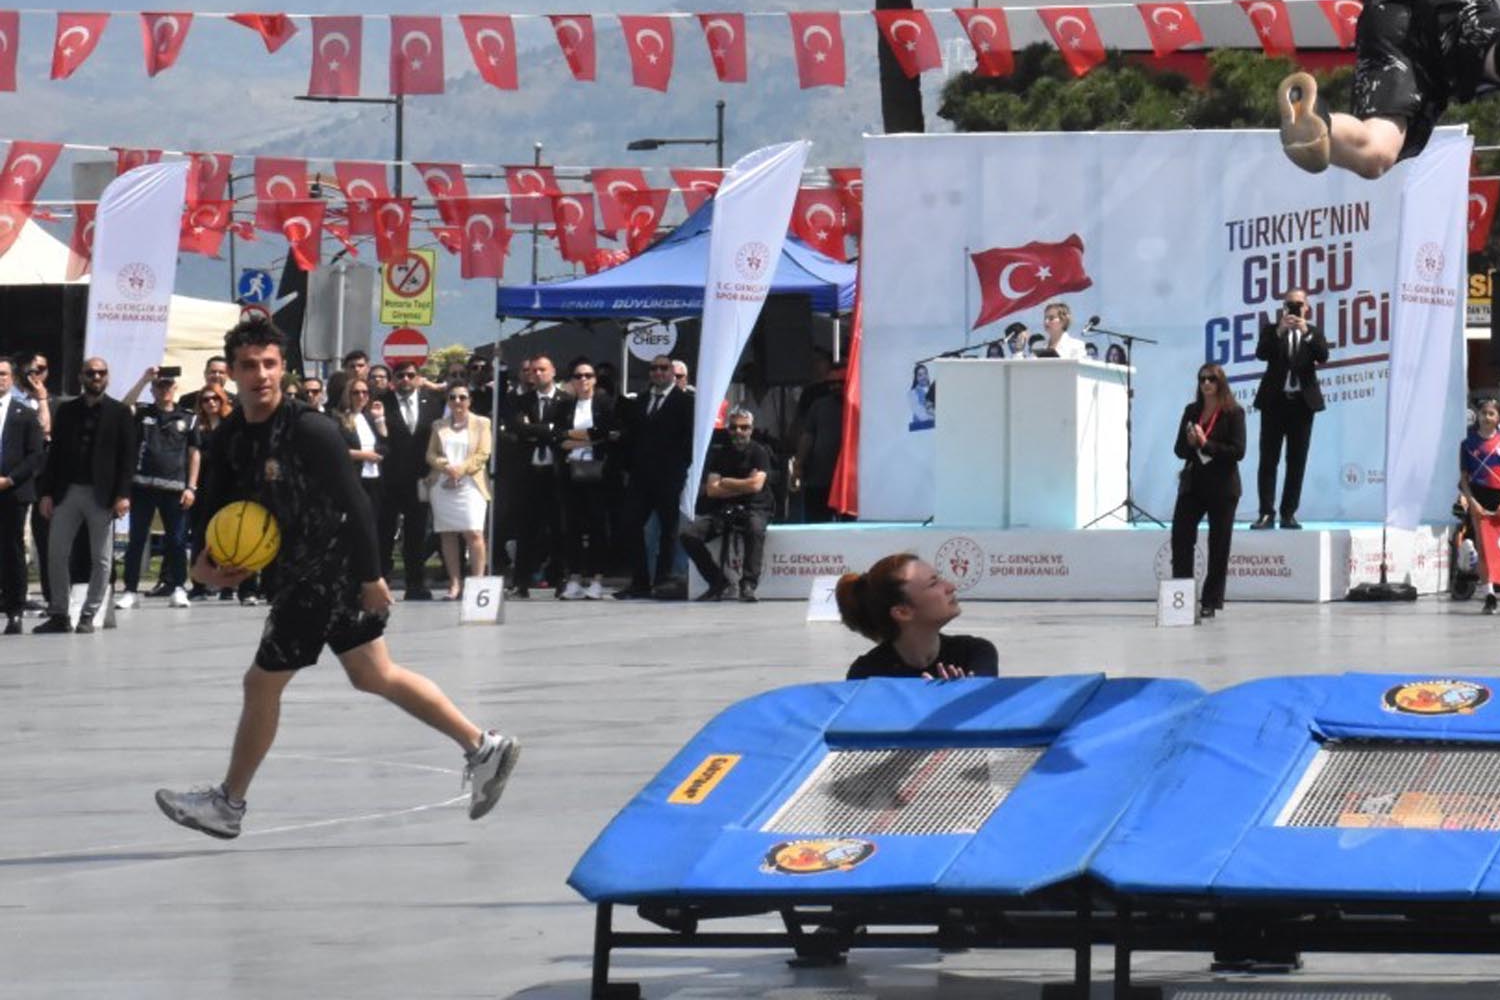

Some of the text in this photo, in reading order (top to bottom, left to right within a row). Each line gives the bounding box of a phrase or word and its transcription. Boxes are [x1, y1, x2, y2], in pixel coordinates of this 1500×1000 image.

[1226, 201, 1369, 252] TÜRKİYE'NİN
[1243, 242, 1352, 305] GÜCÜ
[633, 335, 671, 345] CHEFS
[833, 554, 844, 564] VE
[990, 554, 1006, 564] T.C.
[1051, 554, 1063, 564] VE
[1273, 554, 1285, 565] VE
[771, 566, 797, 576] SPOR
[989, 566, 1016, 576] SPOR
[477, 589, 490, 608] 6
[1173, 591, 1185, 610] 8
